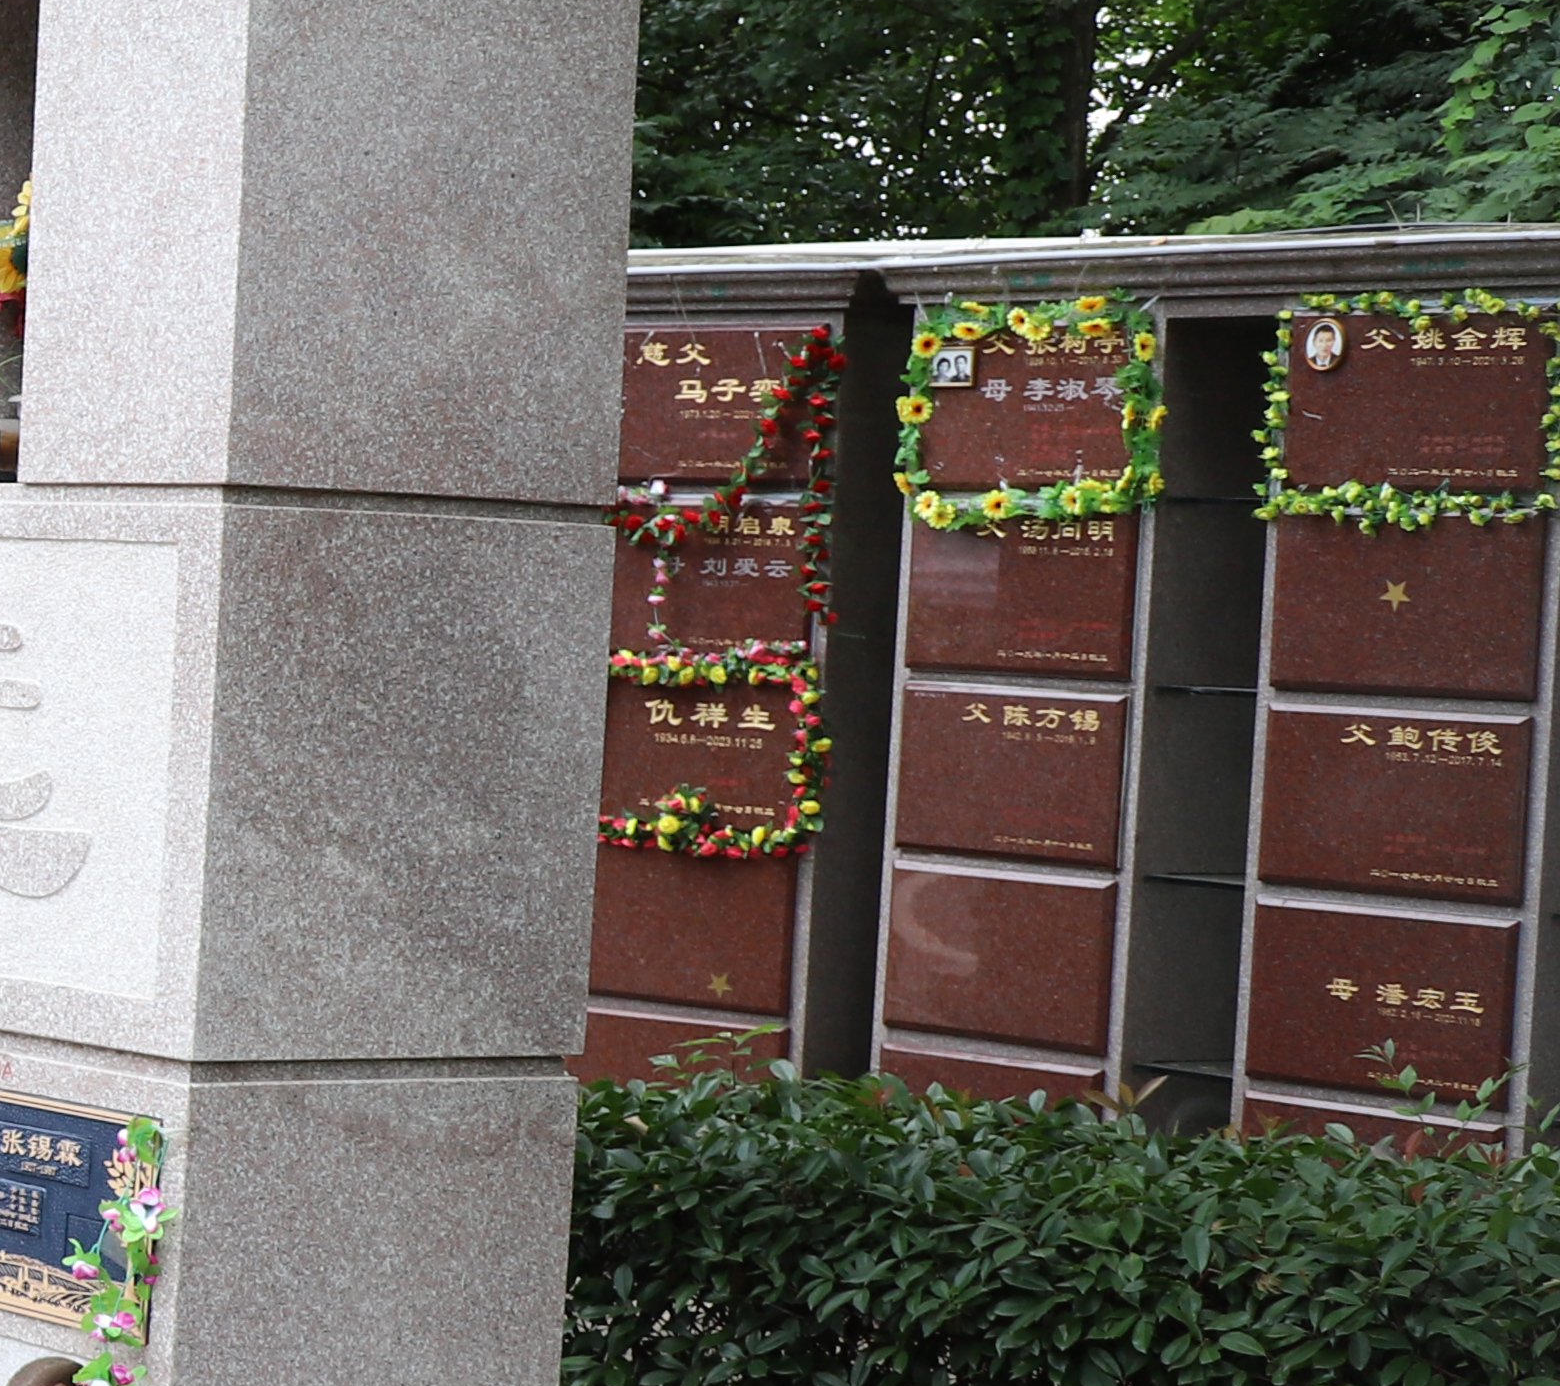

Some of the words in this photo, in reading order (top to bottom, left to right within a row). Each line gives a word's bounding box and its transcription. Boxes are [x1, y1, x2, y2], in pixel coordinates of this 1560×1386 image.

[982, 333, 1016, 356] 父
[1360, 327, 1397, 351] 父
[1410, 326, 1528, 352] 姚金辉
[636, 342, 711, 367] 慈父
[980, 378, 1013, 403] 母
[700, 557, 794, 579] 刘爱云
[645, 698, 776, 732] 仇祥生
[961, 702, 992, 725] 父
[1002, 704, 1102, 733] 陈方锡
[1339, 722, 1377, 747] 父
[1324, 977, 1360, 1002] 母
[0, 1127, 84, 1168] 张锡霖
